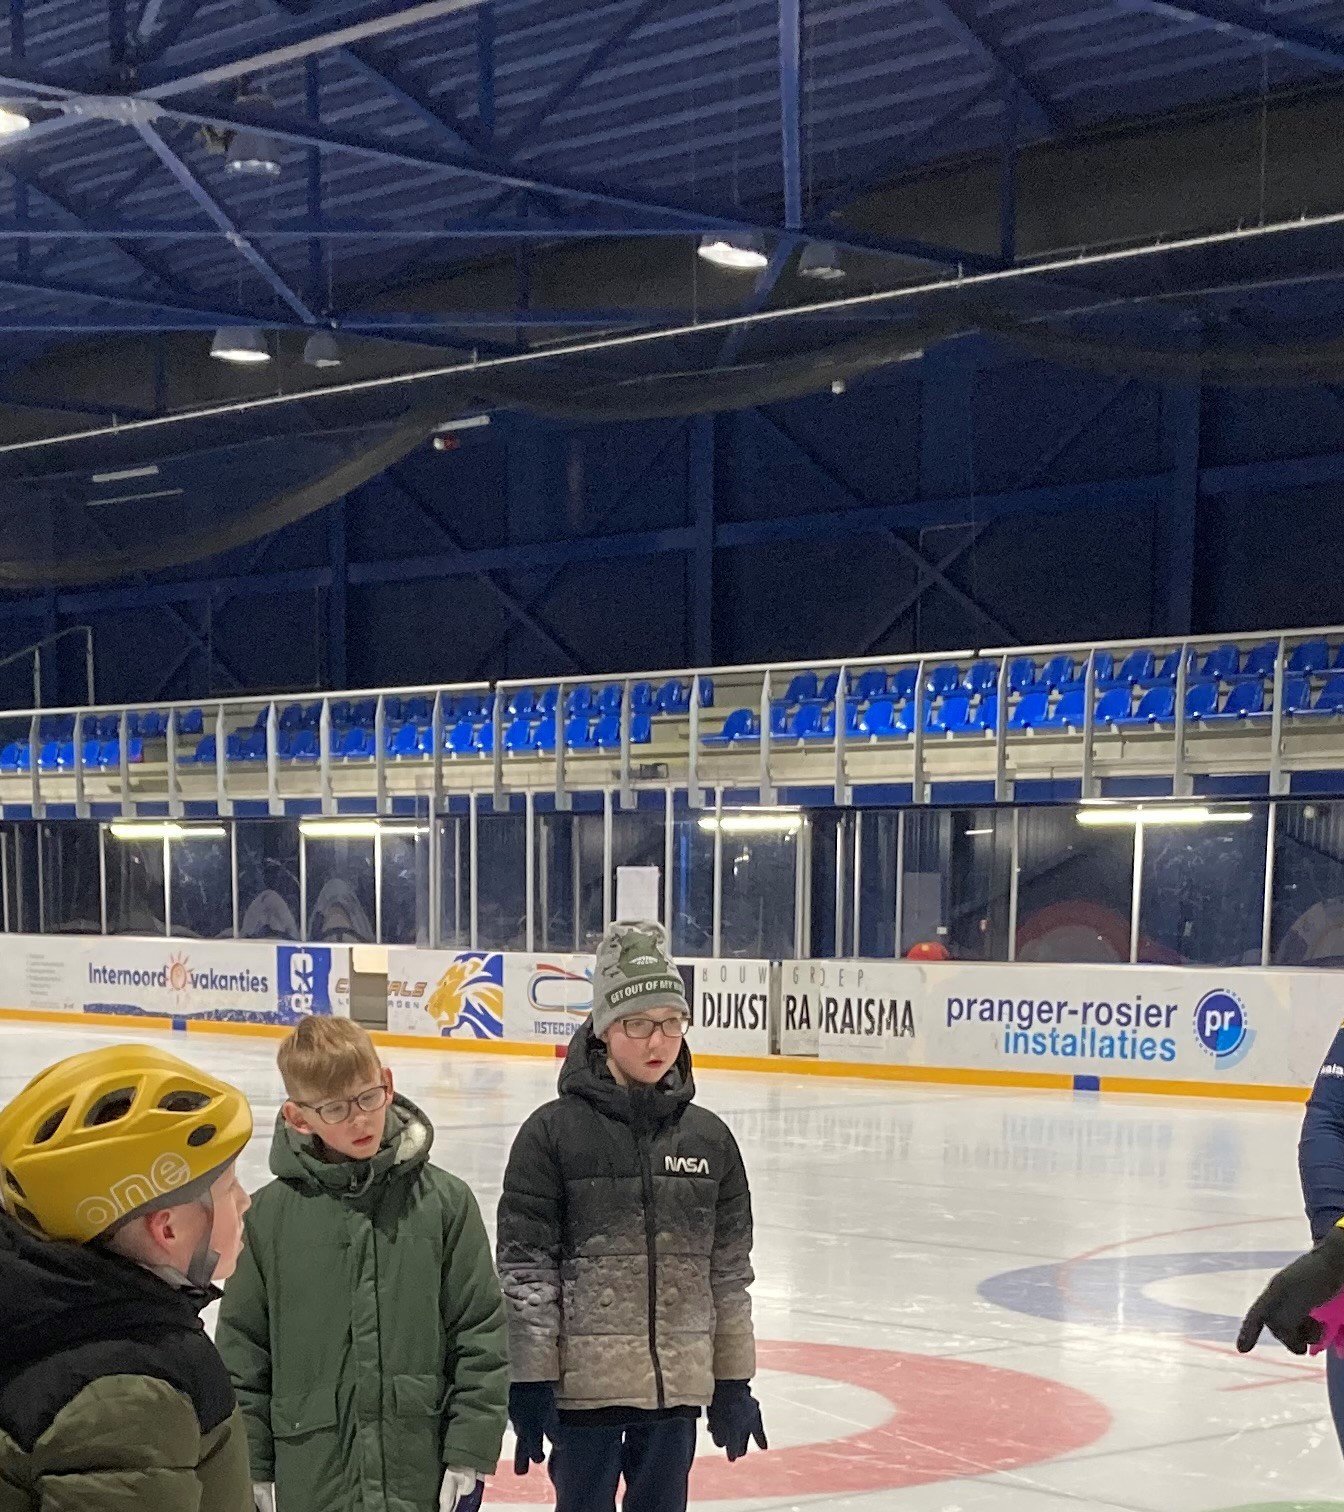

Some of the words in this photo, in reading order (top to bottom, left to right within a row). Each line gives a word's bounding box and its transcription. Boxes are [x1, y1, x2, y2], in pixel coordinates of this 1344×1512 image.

[88, 962, 167, 987] Internoord
[190, 968, 268, 993] vakanties
[610, 989, 624, 1004] GET
[624, 982, 644, 997] OUT
[645, 980, 659, 991] OF
[946, 995, 1178, 1030] pranger-rosier
[1204, 1008, 1236, 1037] pr
[1003, 1024, 1177, 1062] installaties
[664, 1155, 710, 1175] NASA
[75, 1151, 192, 1226] one
